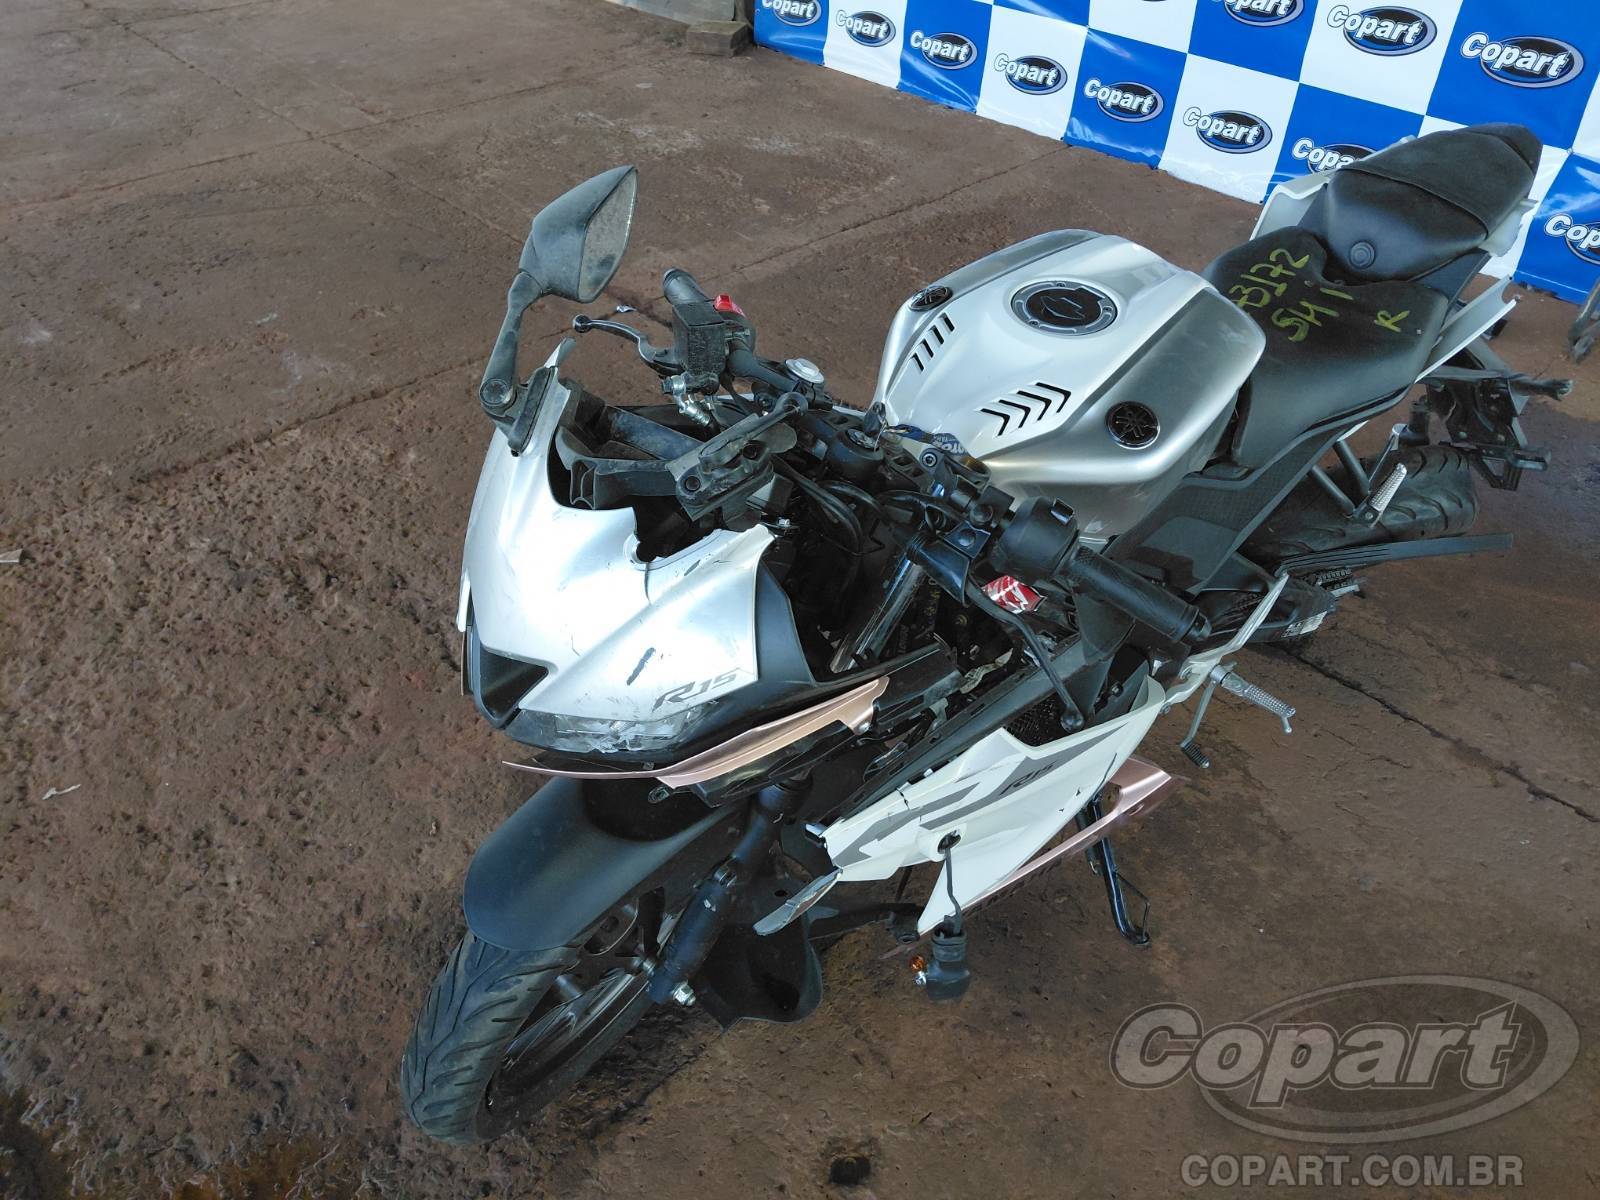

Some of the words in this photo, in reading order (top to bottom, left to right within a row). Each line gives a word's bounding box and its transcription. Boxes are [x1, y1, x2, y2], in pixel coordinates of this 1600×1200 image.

[836, 9, 890, 40] Copart
[1211, 0, 1292, 17] part
[1327, 4, 1424, 46] Copart
[911, 30, 971, 62] Copart
[1460, 31, 1570, 80] Copart
[994, 53, 1058, 87] Copart
[1084, 77, 1156, 117] Copart
[1183, 106, 1261, 146] Copart
[652, 674, 737, 712] R15
